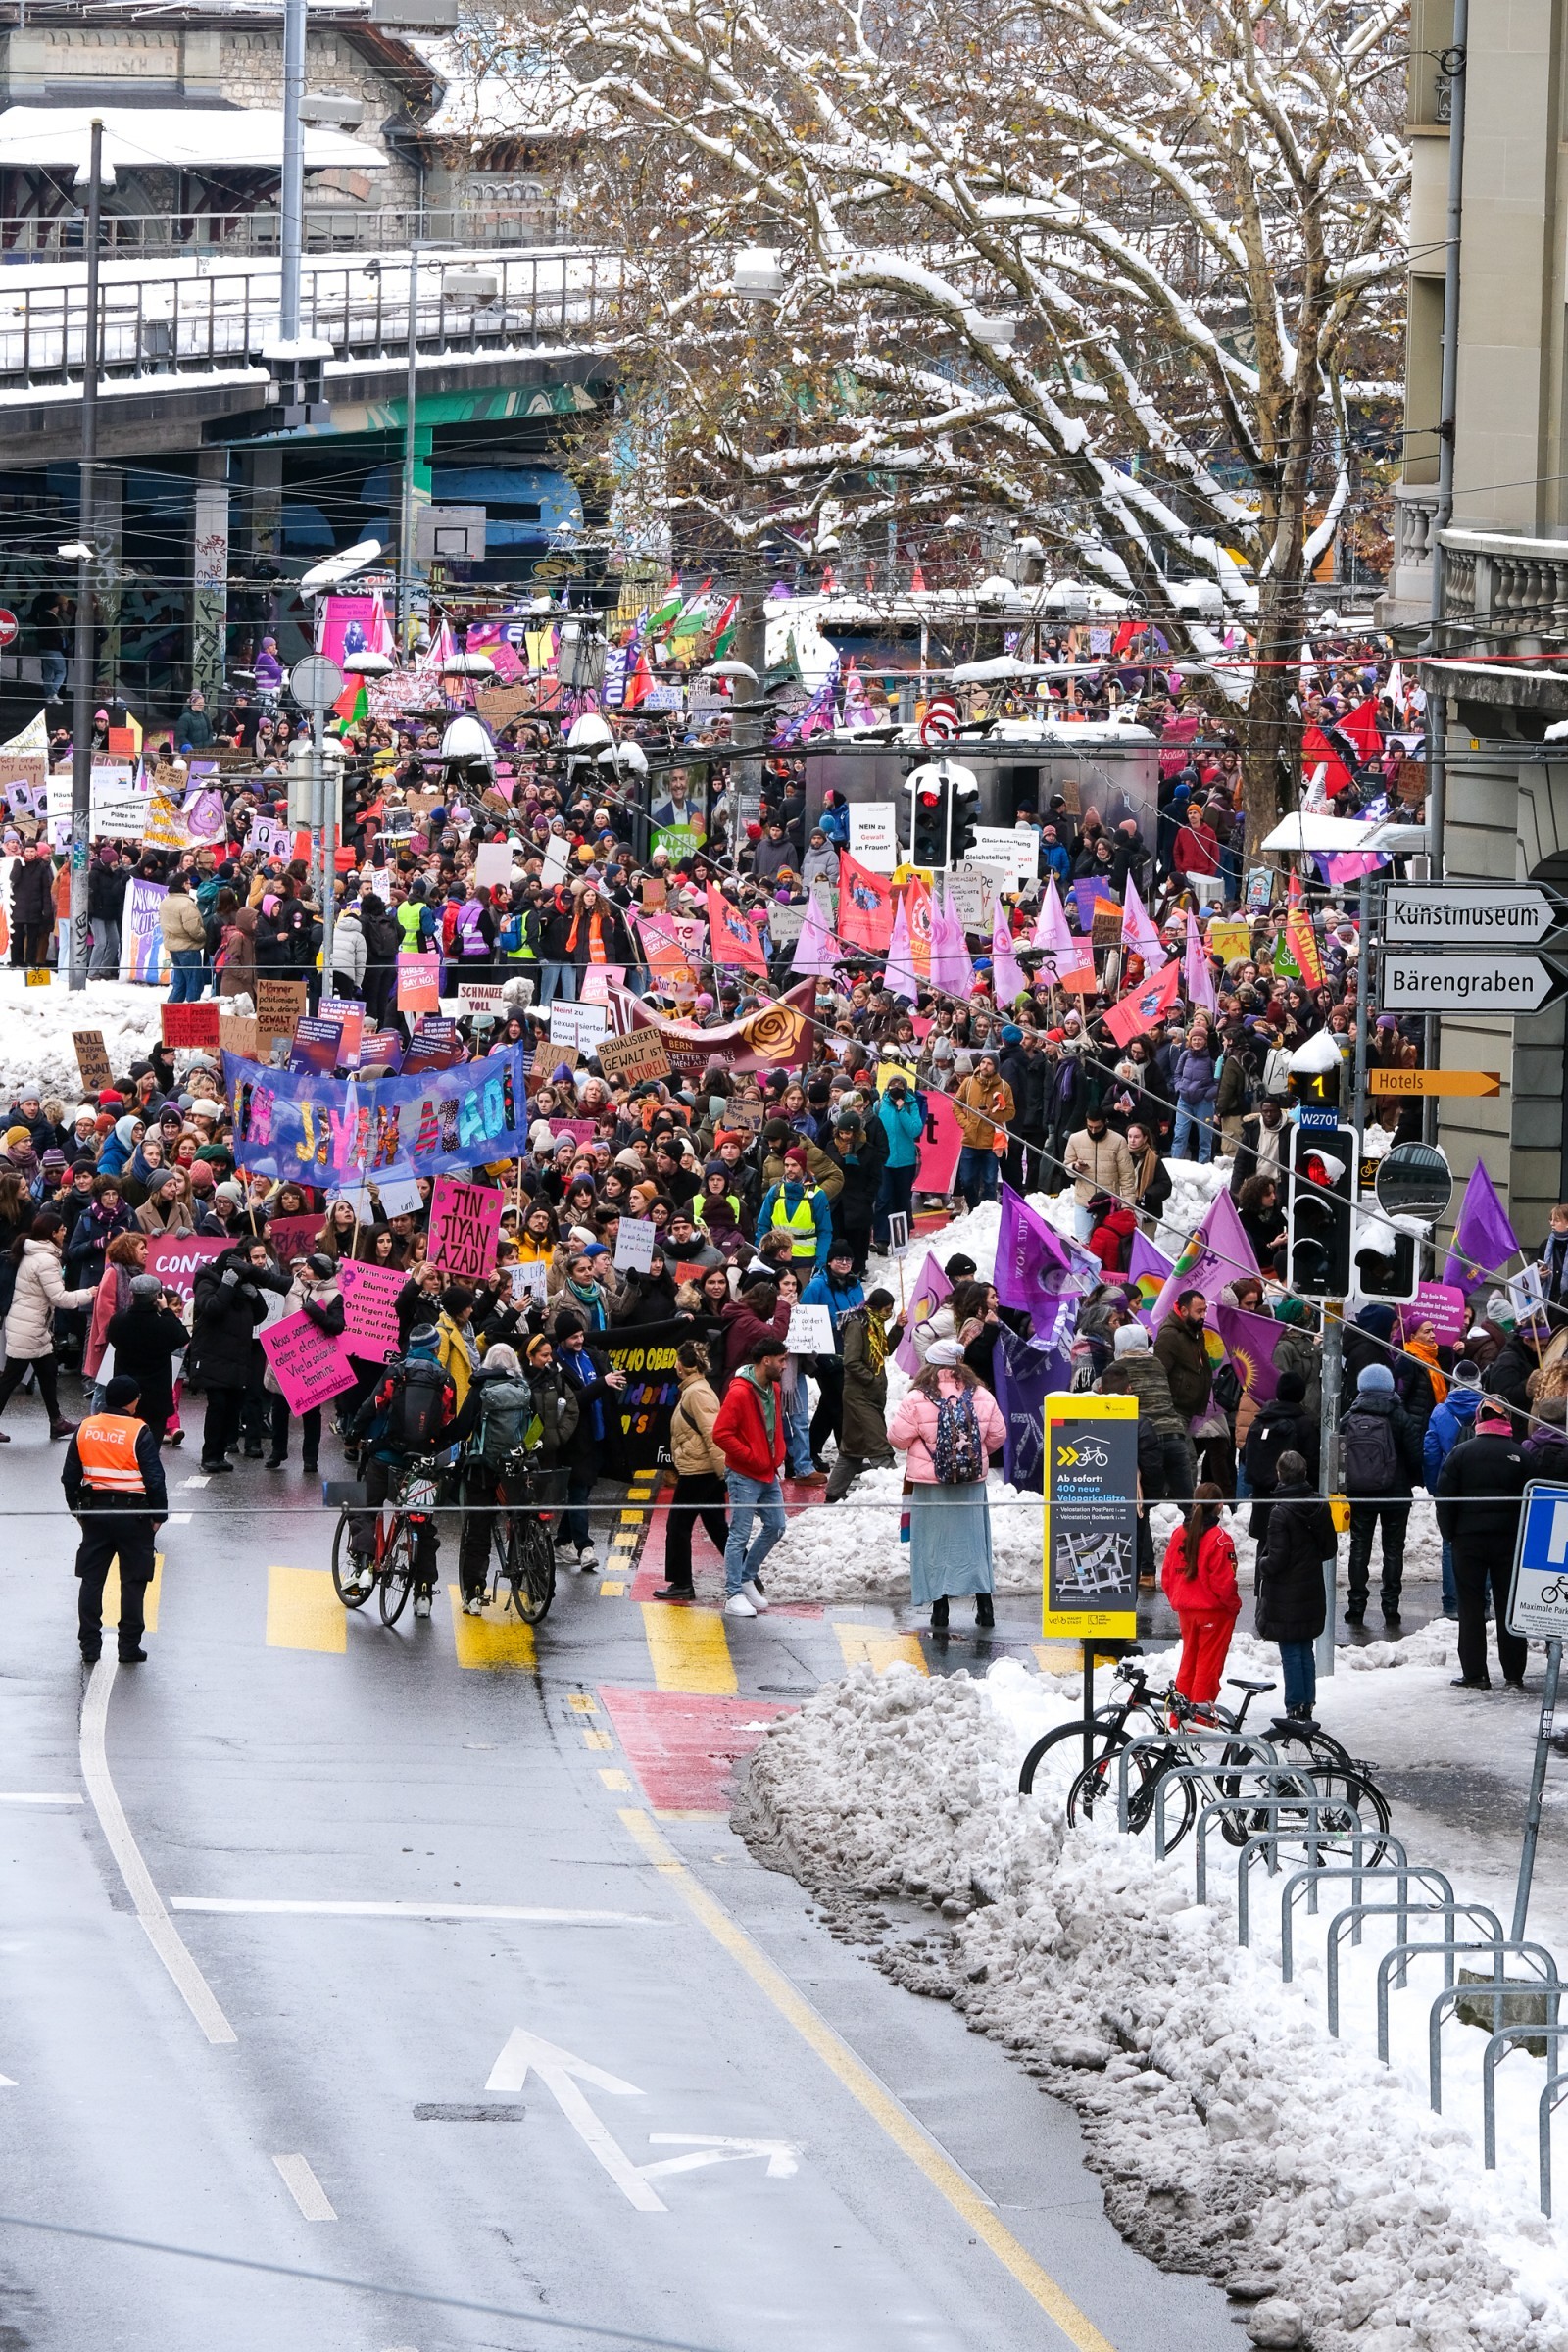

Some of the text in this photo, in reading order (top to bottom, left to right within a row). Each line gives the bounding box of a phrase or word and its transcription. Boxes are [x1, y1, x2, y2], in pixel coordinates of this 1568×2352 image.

[658, 833, 698, 846] WYTER
[965, 854, 1011, 862] Gleichstellung
[1394, 902, 1539, 927] Kunstmuseum
[648, 940, 661, 954] SAY
[1078, 957, 1092, 968] NO!
[402, 974, 434, 989] SAY NO!
[1393, 969, 1535, 997] Bärengraben
[460, 986, 503, 999] SCHNAUZE
[468, 1001, 493, 1012] VOLL
[553, 1006, 573, 1016] Nein!
[258, 1015, 292, 1025] GEWALT
[258, 1023, 290, 1034] zurück
[74, 1033, 104, 1046] NULL
[552, 1032, 592, 1044] Gewal als
[599, 1029, 660, 1055] SEXUALISIERTE
[668, 1040, 694, 1051] BERN
[604, 1046, 662, 1071] GEWALT IST
[671, 1053, 701, 1062] BETTER
[80, 1062, 109, 1076] GEWALT
[1379, 1073, 1424, 1090] Hotels
[1301, 1113, 1339, 1126] W2701
[156, 1252, 214, 1274] CONT
[357, 1266, 395, 1282] Wenn wir
[363, 1280, 389, 1294] Blume
[353, 1293, 375, 1303] einen
[345, 1302, 383, 1316] Ort legen
[365, 1318, 380, 1327] auf
[270, 1334, 291, 1351] Nous
[364, 1330, 385, 1340] einer
[386, 1334, 400, 1344] Fra
[625, 1348, 646, 1372] NO
[646, 1348, 678, 1371] OBED
[285, 1357, 314, 1378] Vive la
[84, 1429, 126, 1446] POLICE
[656, 1446, 673, 1464] Fra
[1056, 1474, 1103, 1483] Ab sofort:
[1056, 1484, 1076, 1493] 400
[1056, 1494, 1127, 1503] Veloparkplätze
[1519, 1601, 1568, 1615] Maximale Park
